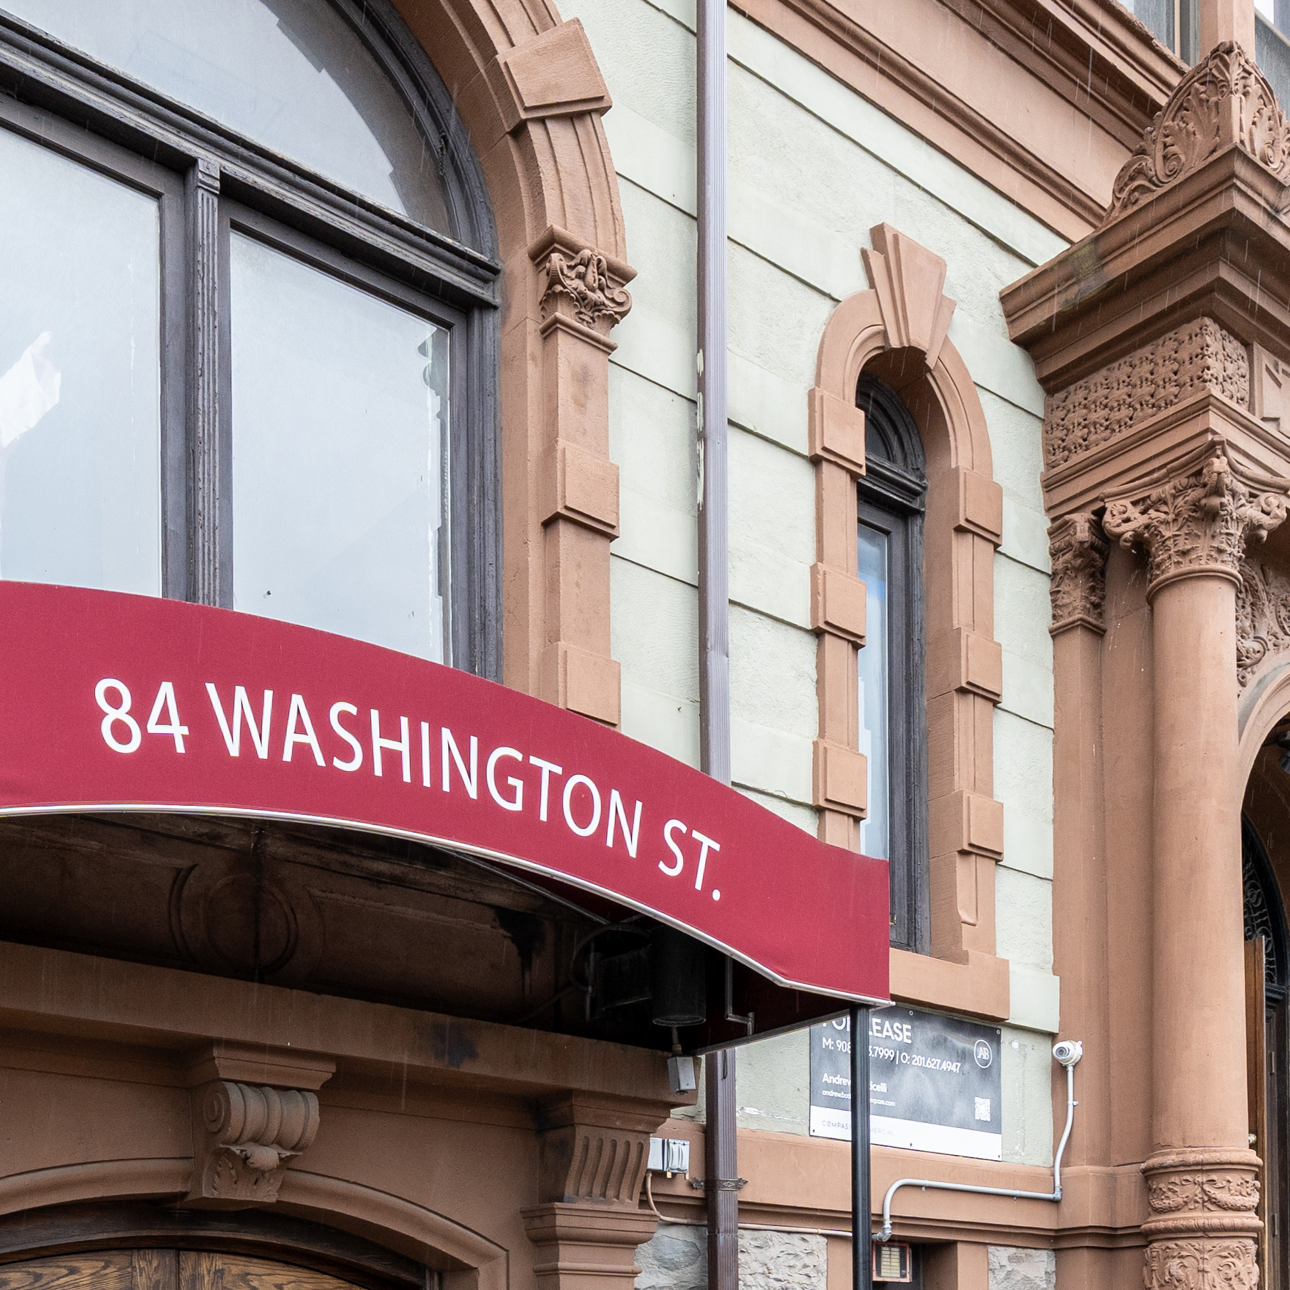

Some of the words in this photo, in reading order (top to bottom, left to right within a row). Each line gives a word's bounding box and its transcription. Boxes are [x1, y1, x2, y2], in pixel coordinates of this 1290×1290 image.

[94, 678, 189, 754] 84
[205, 681, 642, 858] WASHINGTON
[658, 819, 721, 901] ST.
[822, 1036, 834, 1050] M:
[912, 1054, 961, 1074] 201.627.4947
